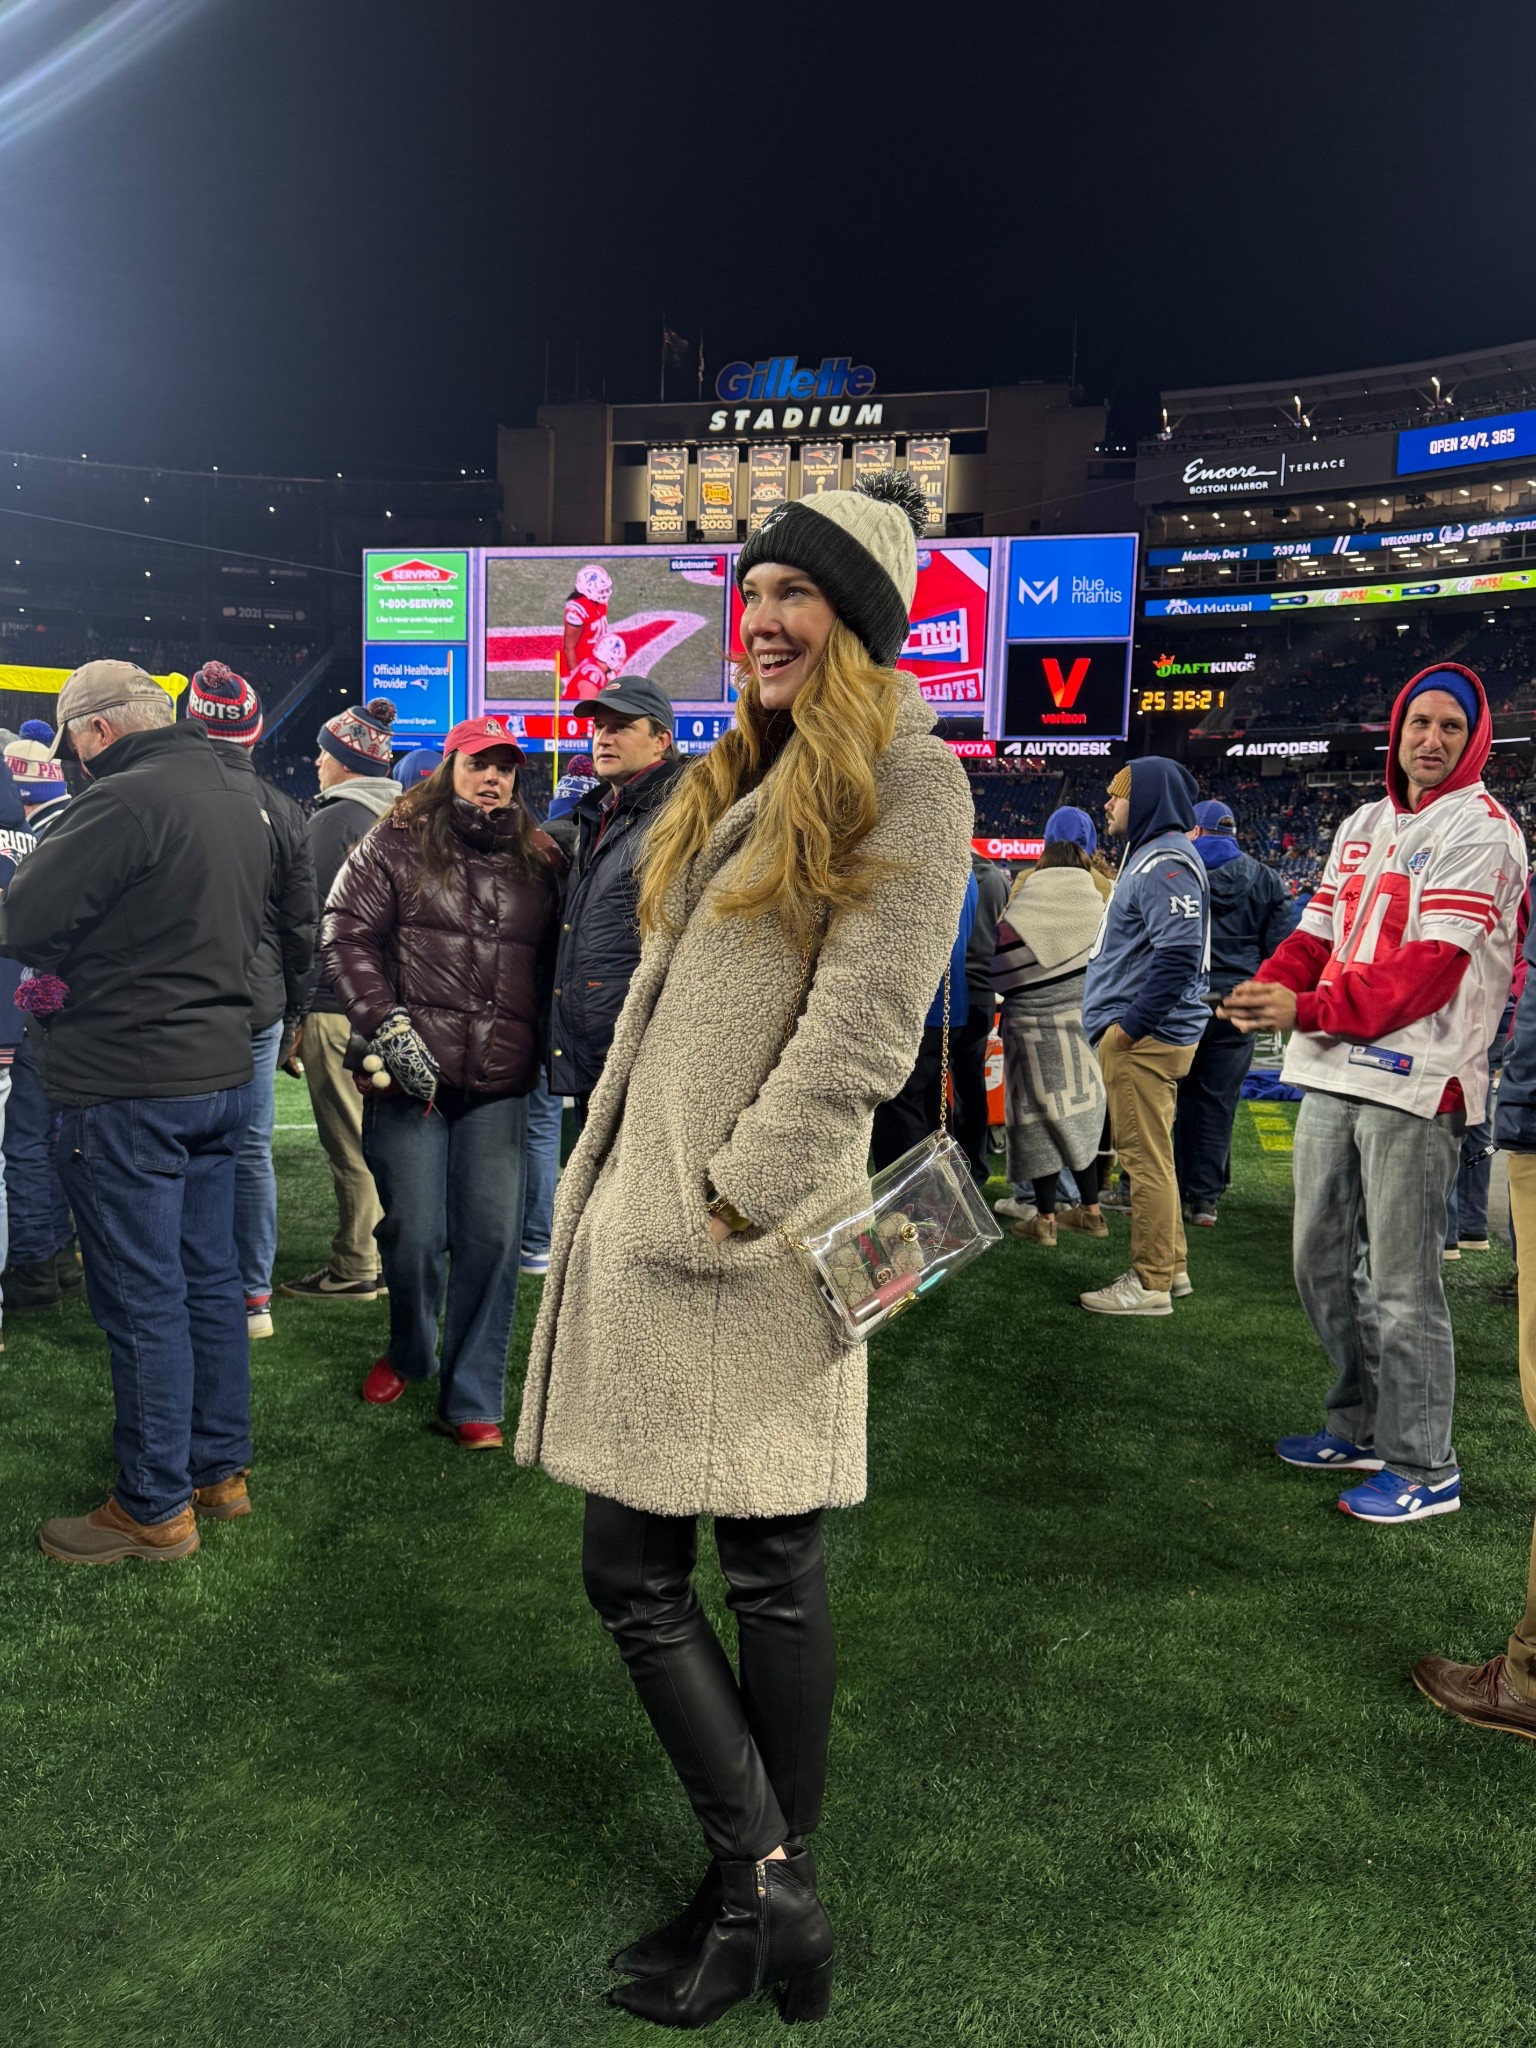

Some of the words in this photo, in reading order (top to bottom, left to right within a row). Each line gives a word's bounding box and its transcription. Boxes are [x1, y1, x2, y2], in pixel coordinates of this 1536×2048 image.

[715, 356, 876, 402] Gillette
[708, 403, 884, 431] STADIUM
[1429, 440, 1457, 455] OPEN
[1460, 433, 1489, 451] 24/7,
[1492, 428, 1515, 444] 365
[1183, 458, 1277, 484] Encore
[1288, 459, 1346, 473] TERRACE
[1189, 484, 1228, 495] BOSTON
[1229, 481, 1268, 492] HARBOR
[652, 521, 681, 531] 2001
[700, 520, 732, 530] 2003
[1381, 534, 1421, 546] WELCOME
[1422, 532, 1434, 542] TO
[1467, 521, 1513, 537] Gillette
[1182, 550, 1221, 562] Monday,
[1222, 549, 1240, 559] Dec
[1242, 548, 1248, 558] 1
[1272, 545, 1294, 556] 7:39
[1295, 543, 1311, 554] PM
[671, 560, 717, 569] ticketmaster
[392, 570, 439, 580] SERVPRO
[1072, 576, 1104, 591] blue
[378, 598, 454, 609] 1-800-SERVPRO
[1072, 588, 1122, 604] mantis
[238, 607, 262, 618] 2021
[1203, 601, 1252, 614] Mutual
[918, 619, 957, 654] ny
[373, 664, 402, 675] Official
[404, 664, 449, 676] Healthcare
[1156, 661, 1255, 678] DRAFTKINGS
[373, 678, 407, 689] Provider
[1141, 691, 1165, 711] 25
[1172, 690, 1225, 710] 35:21
[1042, 712, 1087, 724] verizon
[567, 720, 578, 736] 0
[693, 720, 704, 737] 0
[1024, 742, 1111, 756] AUTODESK
[1246, 741, 1330, 756] AUTODESK
[987, 839, 1045, 858] Optum
[1343, 844, 1368, 865] C
[1169, 894, 1200, 919] NE
